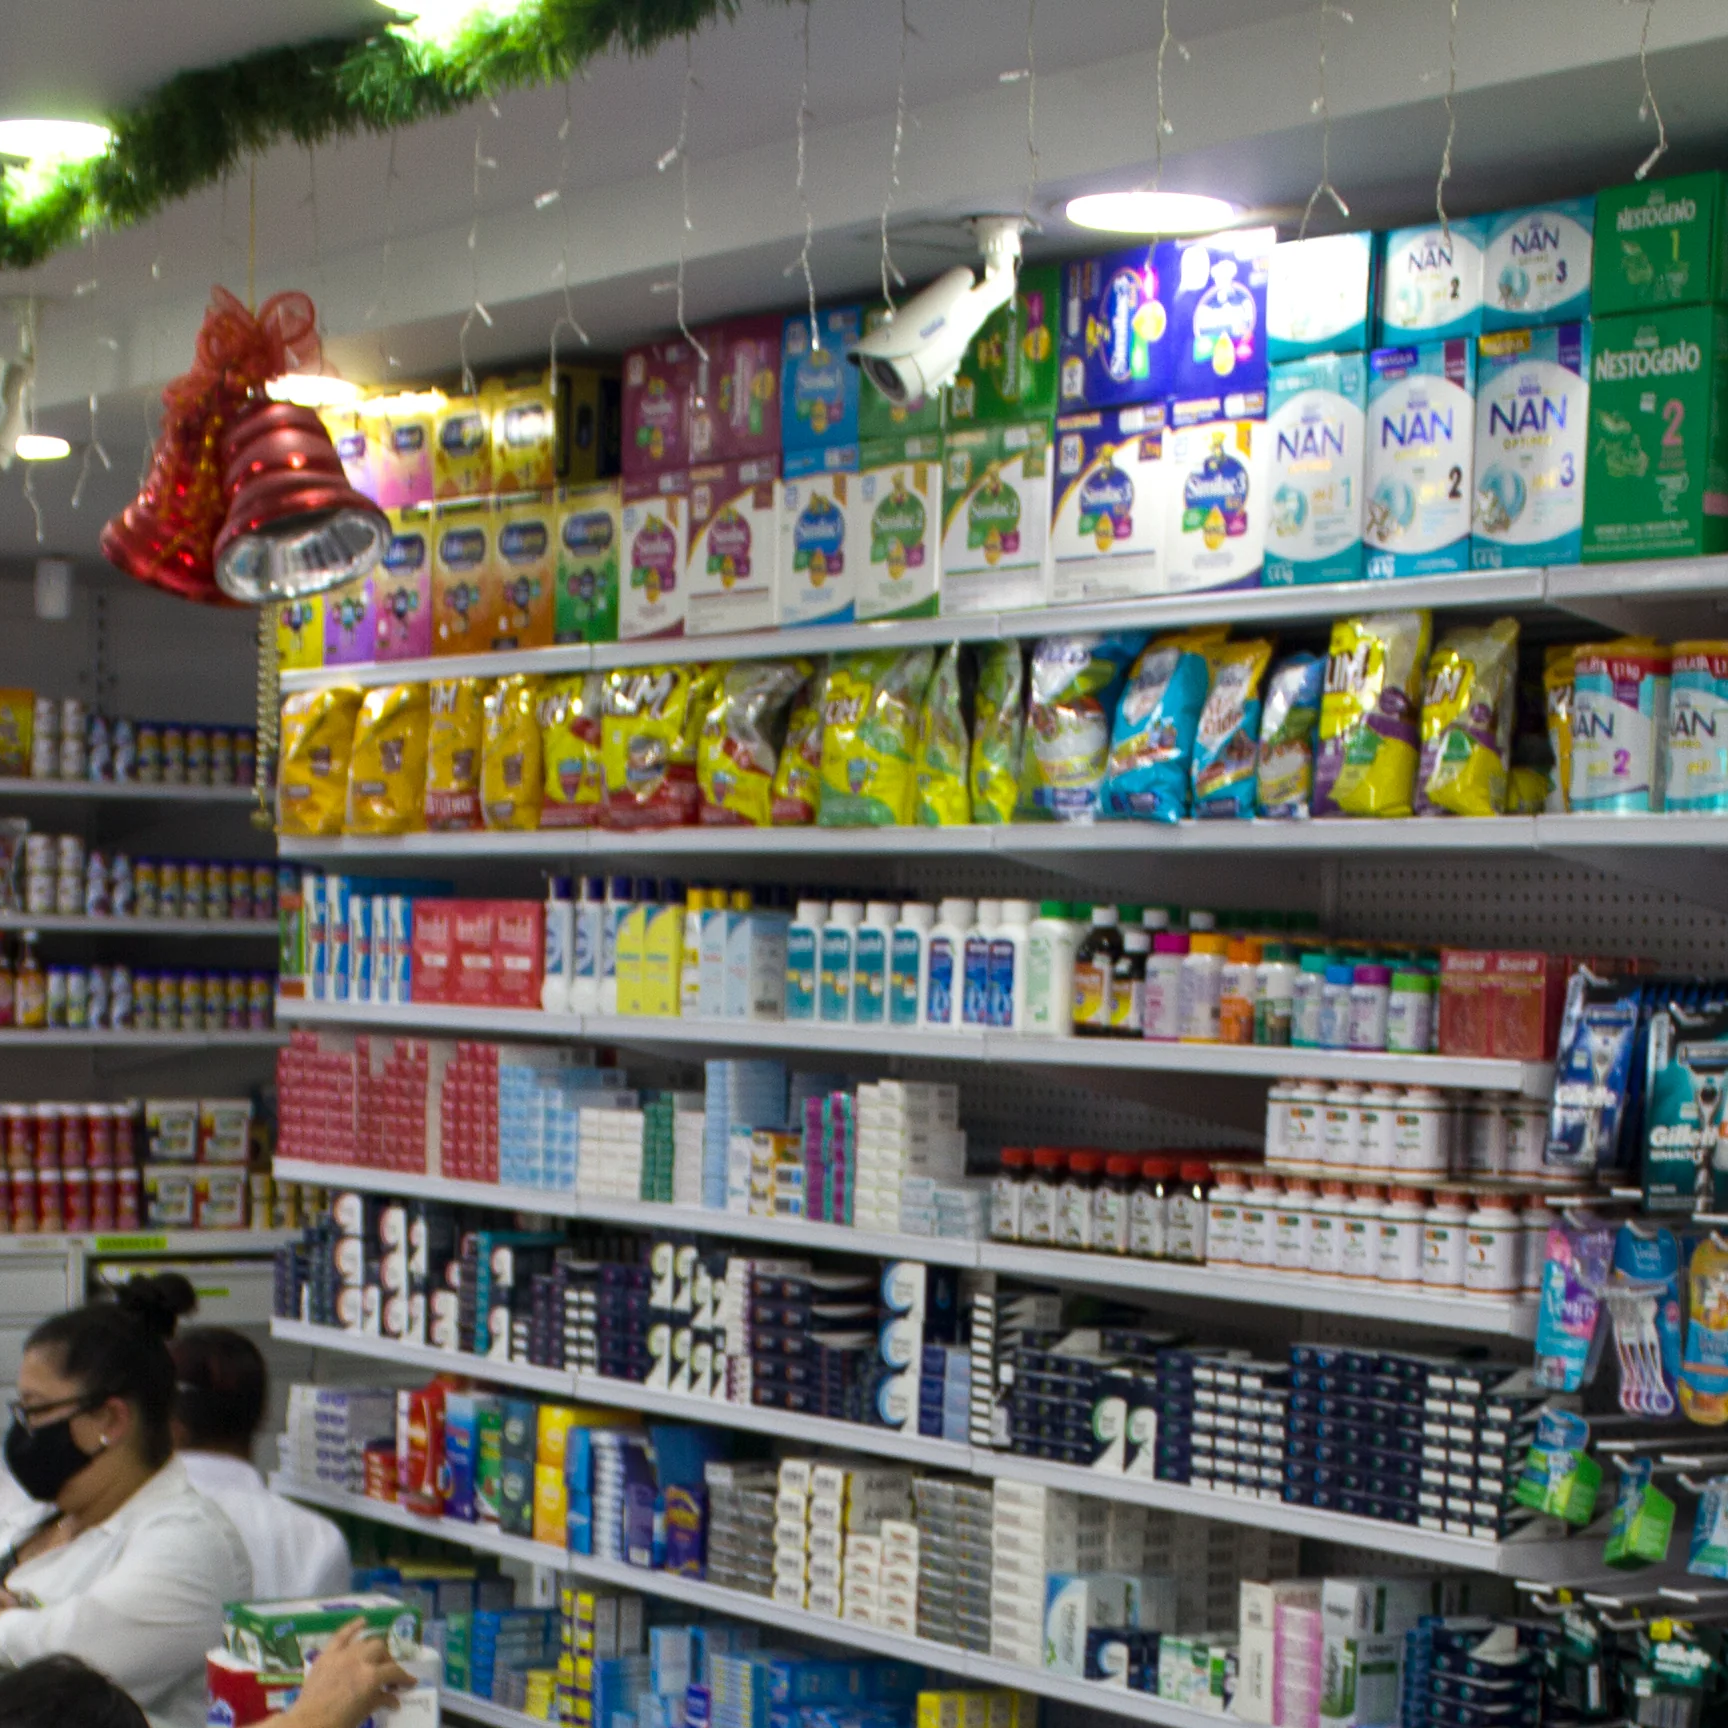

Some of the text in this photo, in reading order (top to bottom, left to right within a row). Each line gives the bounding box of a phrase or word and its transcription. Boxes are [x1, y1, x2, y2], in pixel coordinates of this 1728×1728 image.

[1616, 197, 1696, 232] NESTOGENO
[1511, 226, 1560, 256] NAN
[1595, 344, 1701, 384] NESTOGENO
[1382, 408, 1454, 450] NAN
[1489, 397, 1567, 440] NAN
[1276, 423, 1345, 461] NAN
